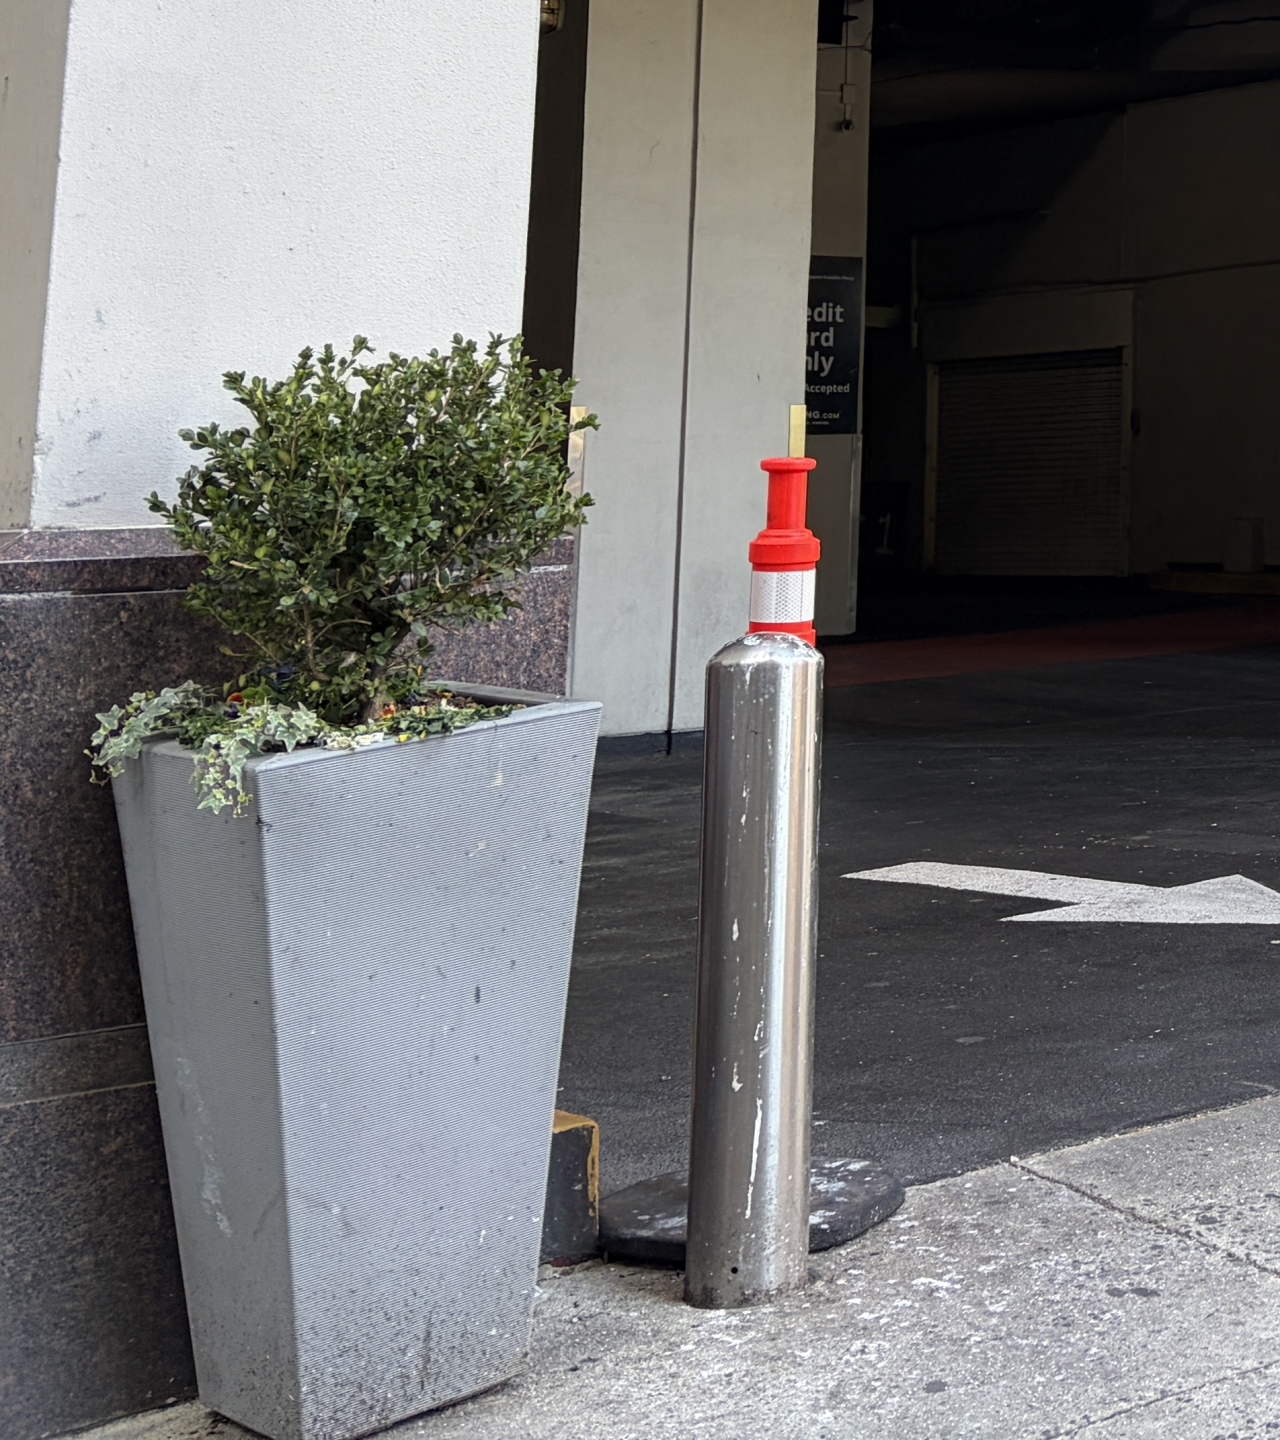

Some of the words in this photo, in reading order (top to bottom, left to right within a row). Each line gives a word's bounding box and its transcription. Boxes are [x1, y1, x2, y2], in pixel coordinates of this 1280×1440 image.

[807, 302, 844, 323] dit
[806, 327, 834, 347] rd
[806, 351, 834, 377] ly
[805, 383, 850, 396] Accepted
[806, 410, 840, 419] NG.COM
